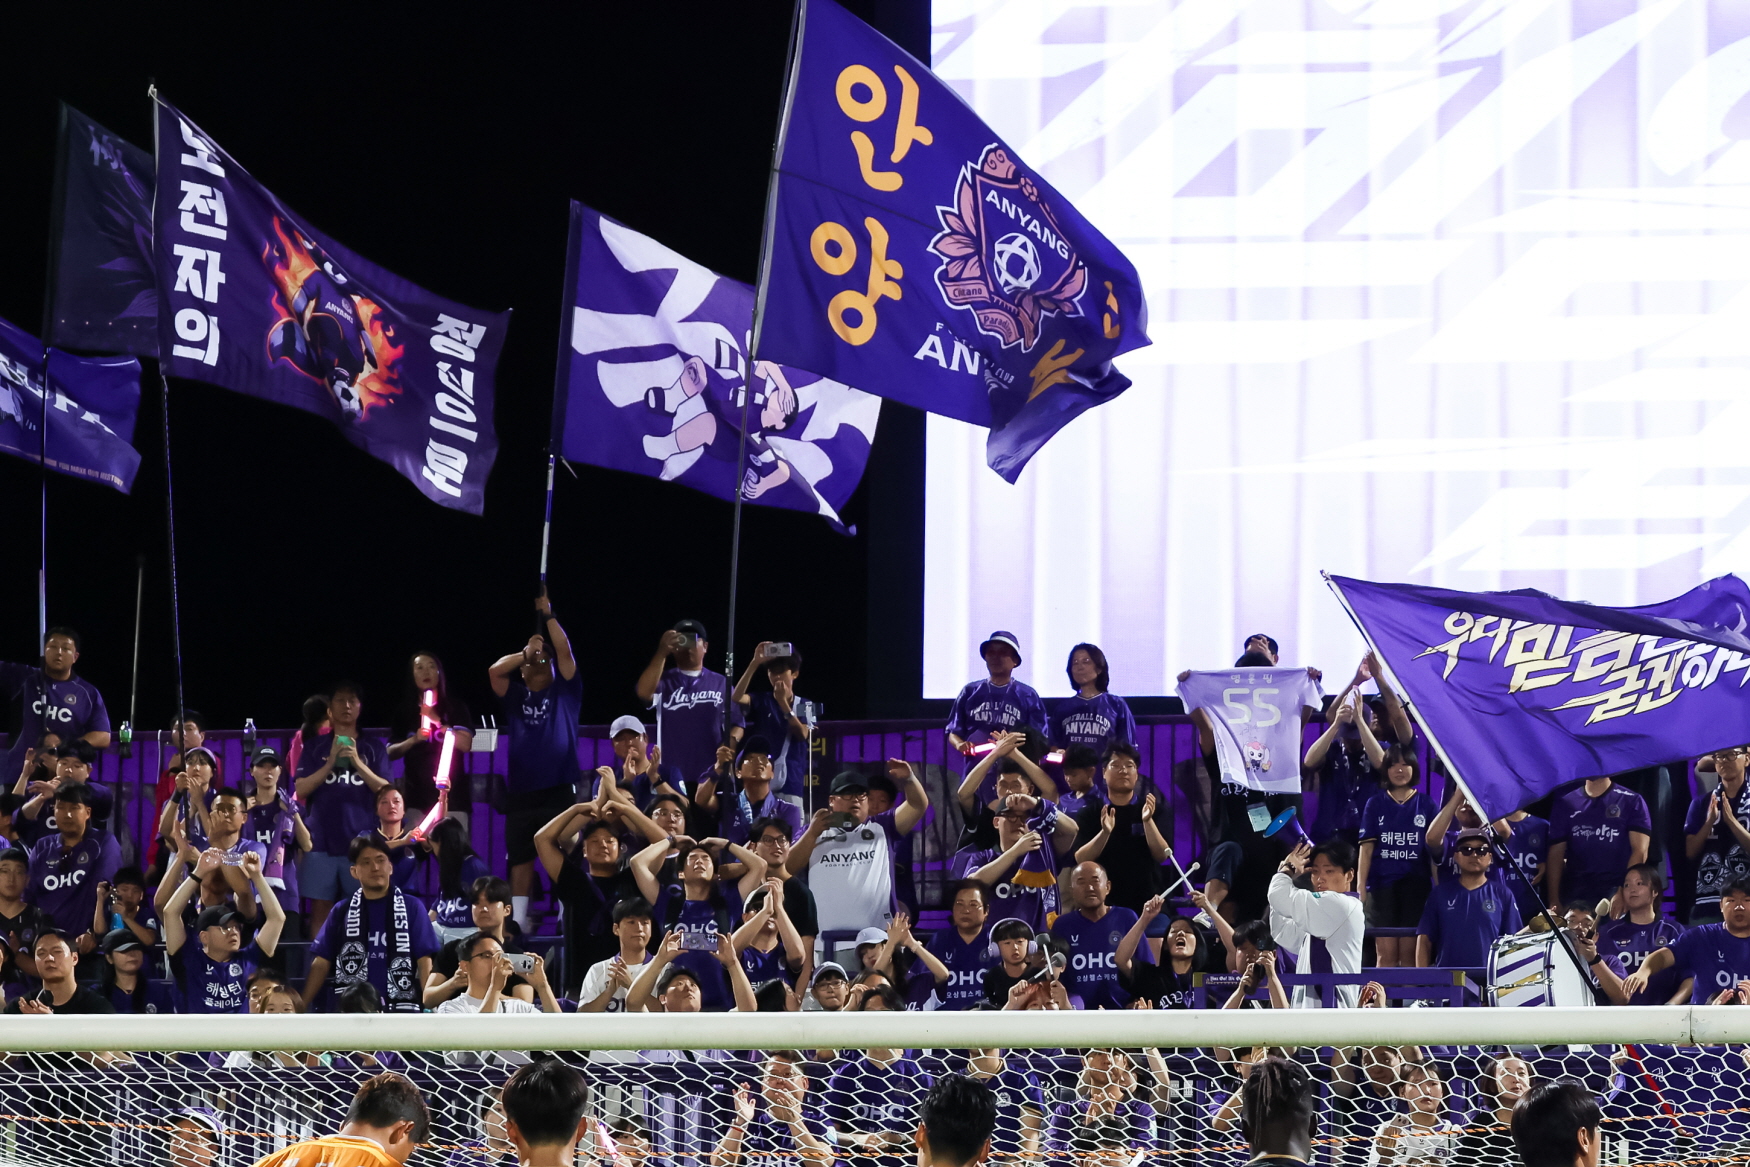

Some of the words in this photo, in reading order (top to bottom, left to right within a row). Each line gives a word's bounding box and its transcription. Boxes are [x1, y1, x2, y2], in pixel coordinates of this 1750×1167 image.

[984, 189, 1070, 261] ANYANG
[1222, 687, 1282, 729] 55
[1380, 830, 1420, 846] 해링턴
[1380, 849, 1419, 860] 플레이스
[43, 868, 87, 891] OHC
[1617, 951, 1651, 969] OH
[946, 989, 985, 999] 오상헬스케
